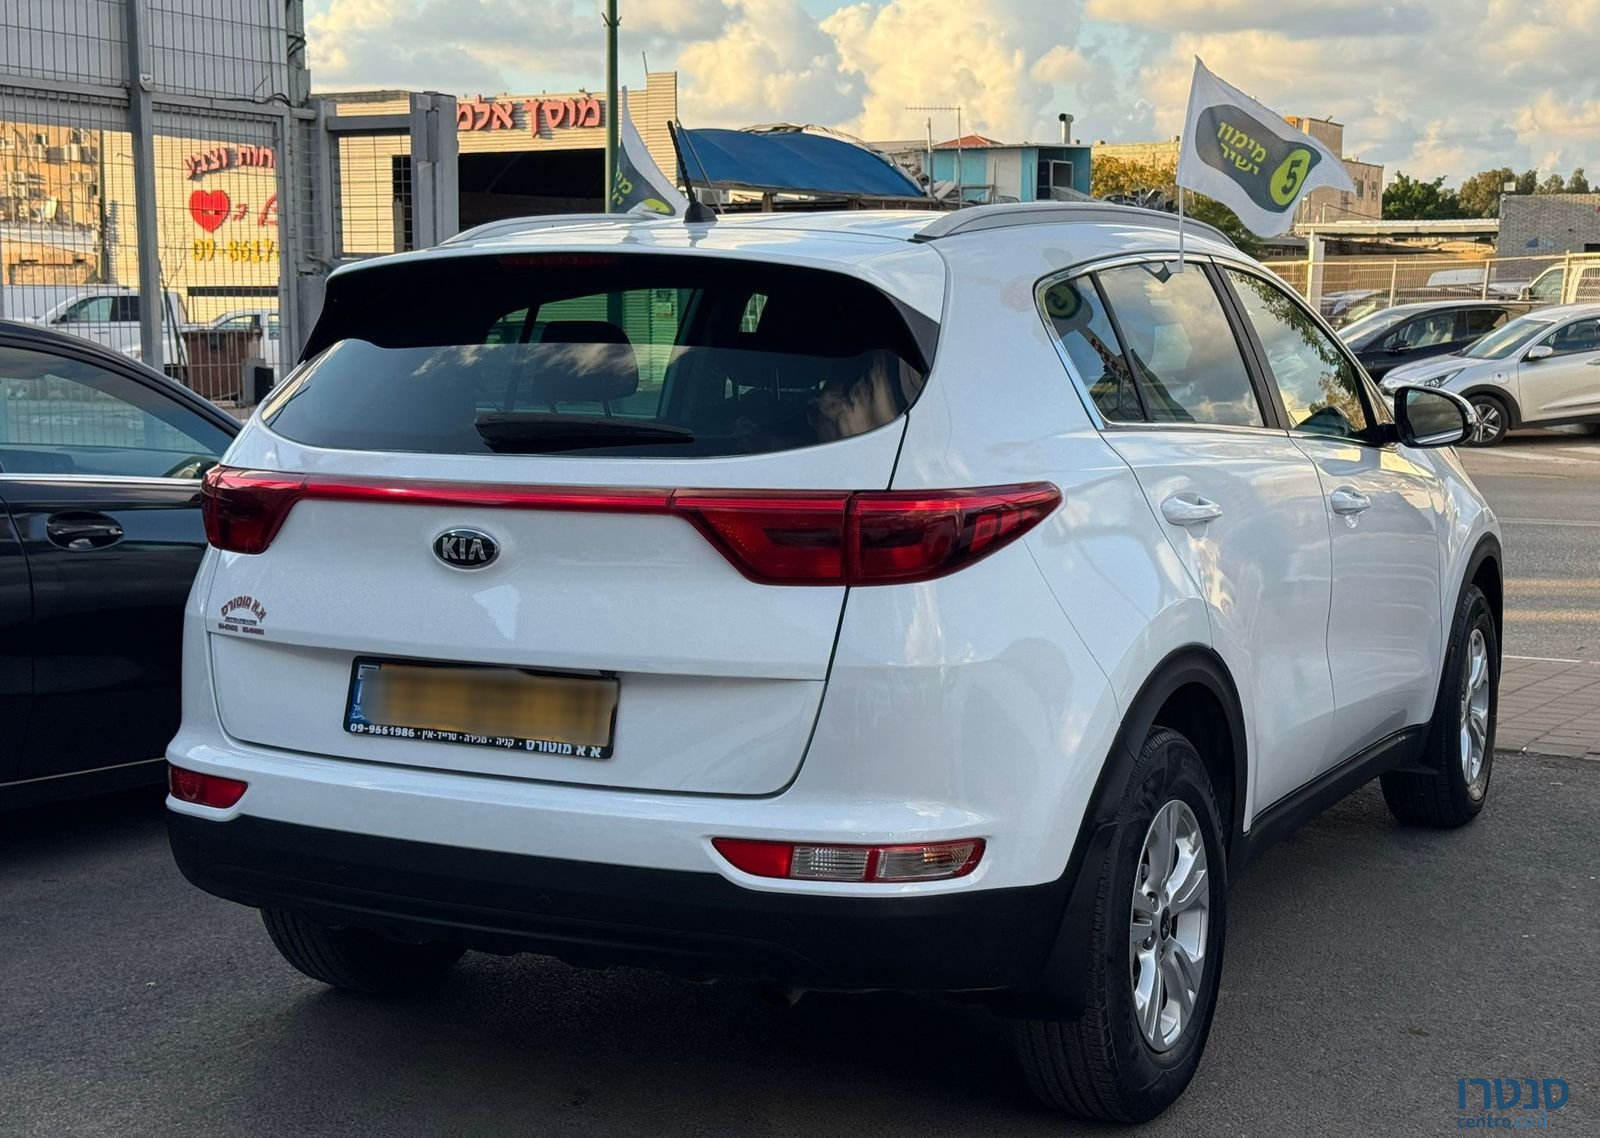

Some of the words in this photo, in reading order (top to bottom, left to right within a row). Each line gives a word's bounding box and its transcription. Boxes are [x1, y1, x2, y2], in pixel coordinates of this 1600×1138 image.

[522, 97, 600, 138] מוסך
[1217, 121, 1267, 163] מימון
[1220, 142, 1259, 175] ישיר
[1281, 159, 1302, 195] 5
[442, 537, 487, 560] KIA
[464, 733, 488, 744] מכירה
[496, 737, 515, 748] קניה
[525, 739, 572, 755] מוטורס
